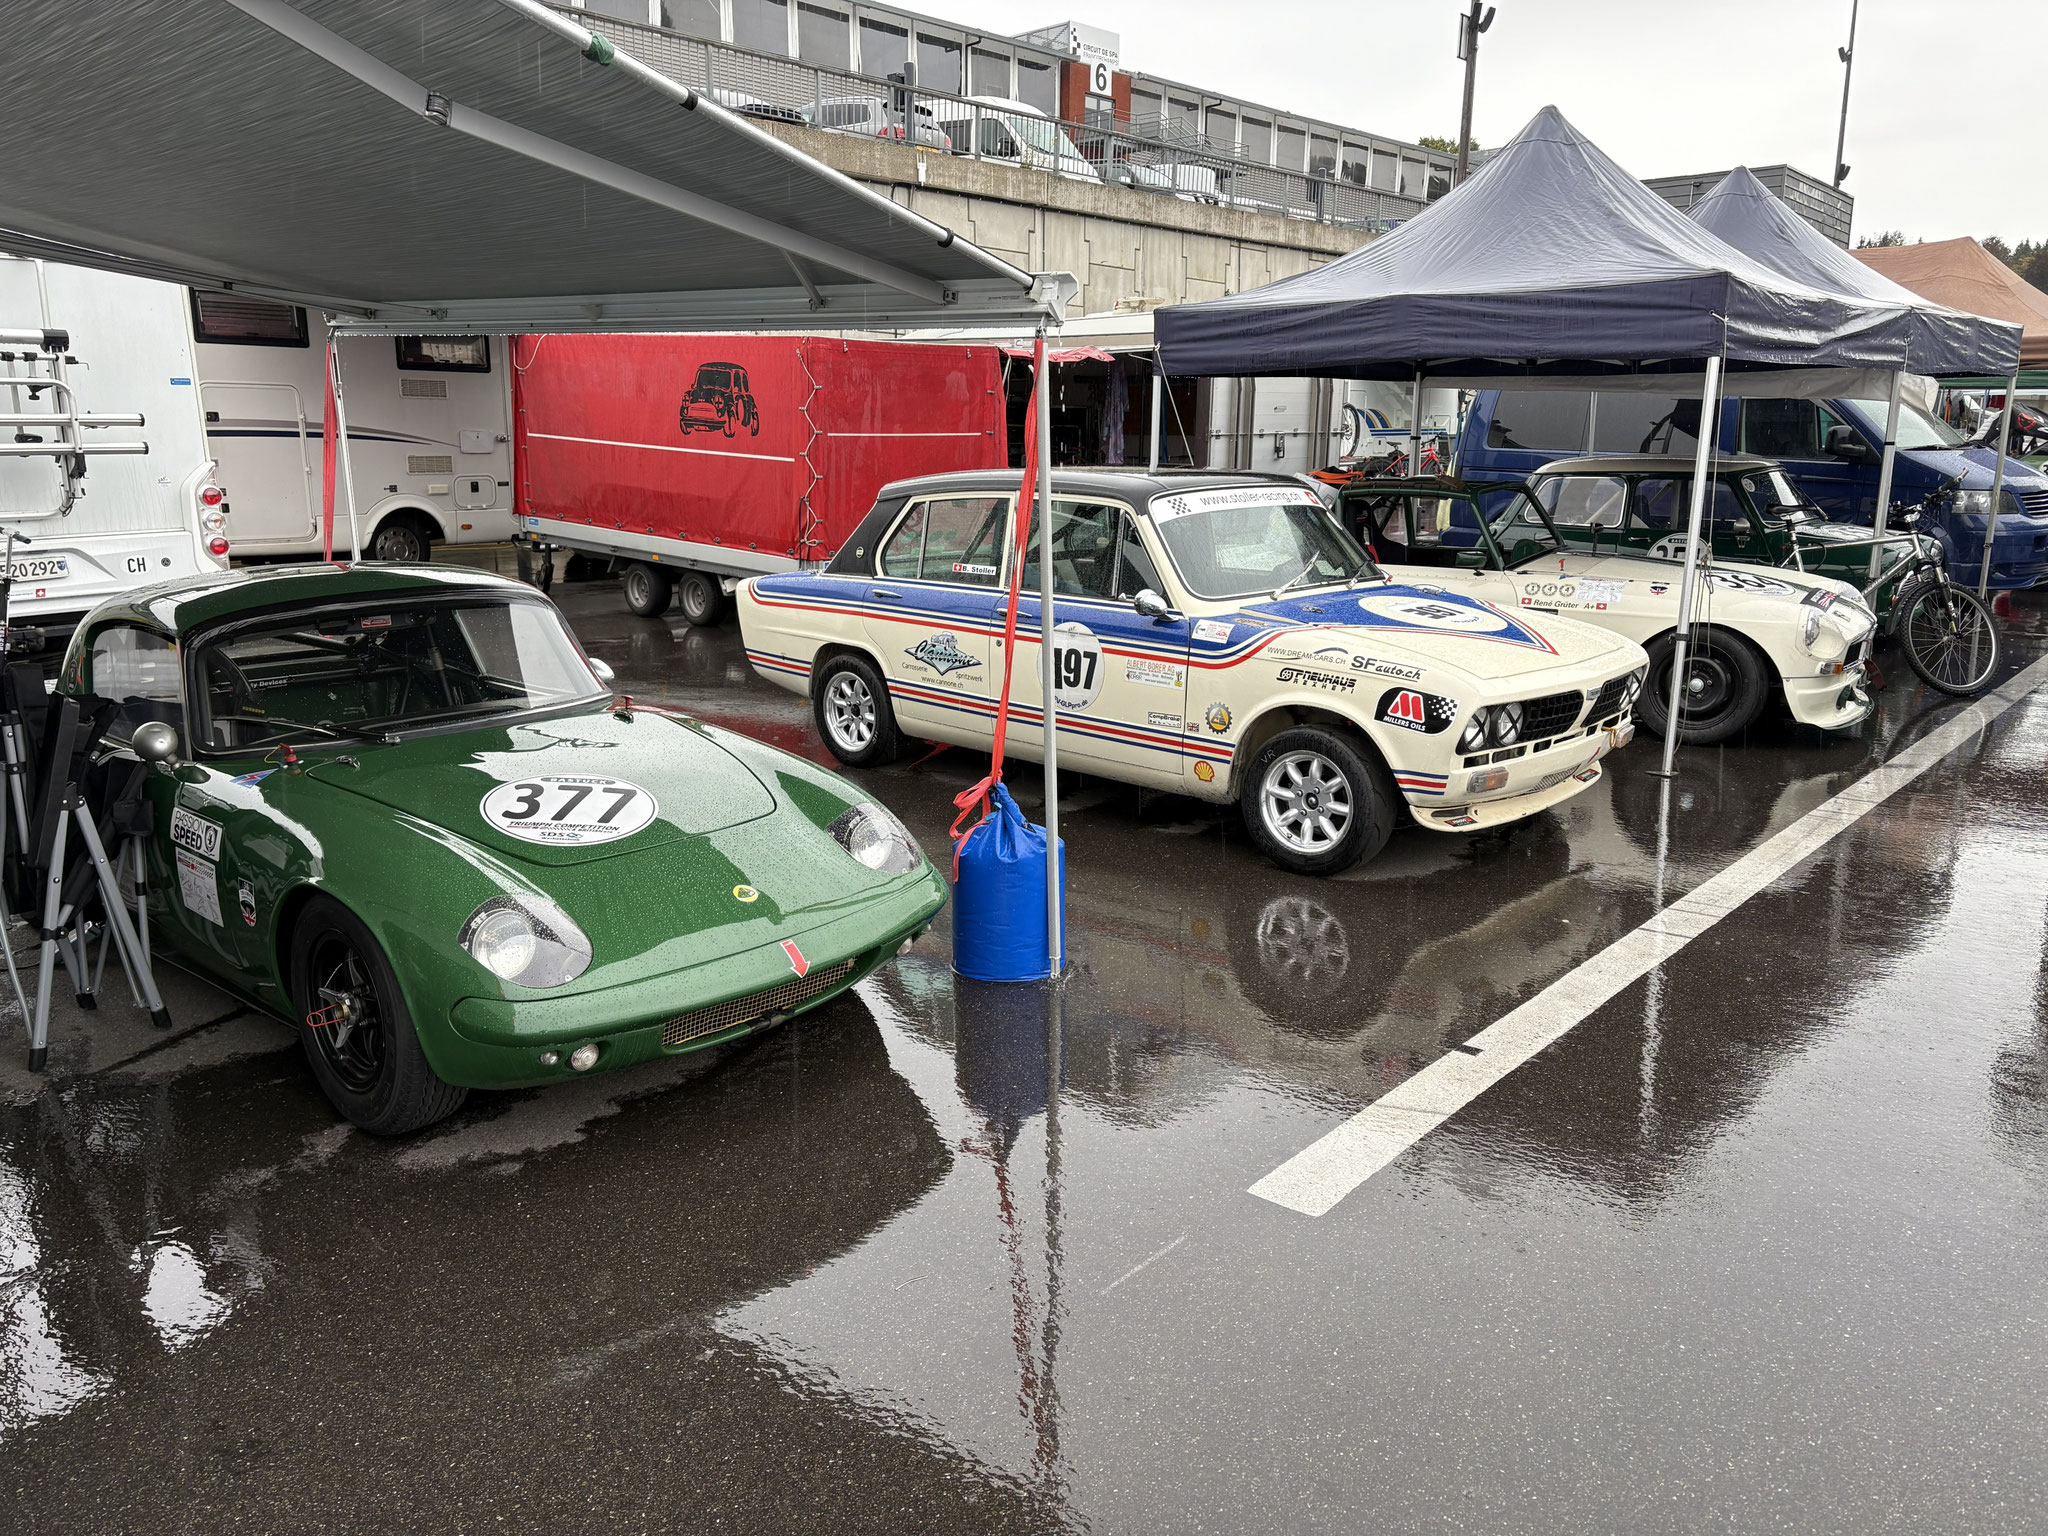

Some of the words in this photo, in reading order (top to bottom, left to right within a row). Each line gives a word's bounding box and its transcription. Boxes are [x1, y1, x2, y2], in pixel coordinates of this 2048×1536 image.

[1083, 44, 1101, 55] CIRCUIT
[1102, 48, 1108, 56] DE
[1109, 50, 1118, 58] SPA
[1095, 62, 1107, 92] 6
[1200, 491, 1303, 506] www.stoller-racing.ch
[127, 557, 147, 573] CH
[971, 566, 995, 574] Stoller
[1554, 600, 1579, 609] Grüter
[1267, 646, 1347, 665] WWW.DREAM-CARS.CH
[901, 661, 928, 673] Carrosserie
[1053, 647, 1098, 690] 197
[1126, 659, 1147, 669] ALBERT
[1147, 661, 1166, 672] BORER
[1166, 665, 1175, 674] AG
[259, 677, 288, 687] Devices
[921, 676, 964, 688] www.cannone.ch
[955, 671, 983, 683] Spritzwerk
[1383, 715, 1410, 727] MILLERS
[1410, 723, 1426, 732] OILS
[550, 777, 608, 785] BASTUCK
[501, 783, 638, 824] 377
[175, 810, 206, 833] PASSION
[554, 822, 620, 831] COMPETITION
[173, 824, 203, 851] SPEED
